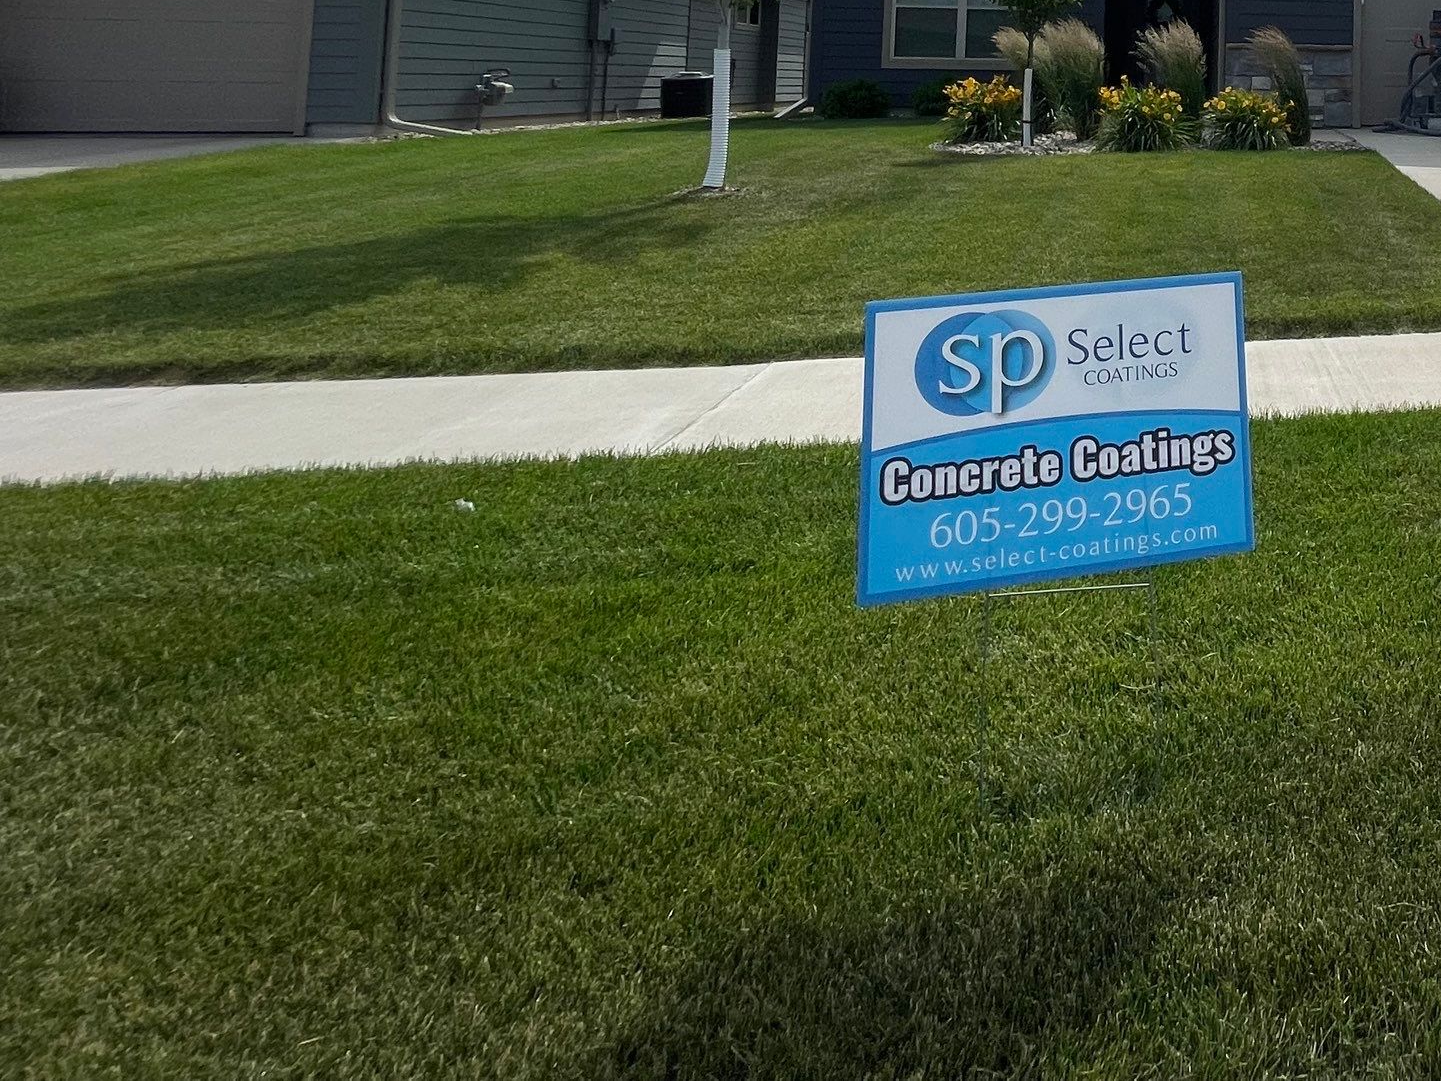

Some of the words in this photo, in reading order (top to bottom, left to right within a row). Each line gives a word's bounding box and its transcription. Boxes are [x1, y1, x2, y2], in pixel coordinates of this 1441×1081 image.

[939, 328, 1044, 414] sp
[1067, 322, 1192, 365] Select
[1083, 361, 1179, 386] COATINGS
[881, 445, 1062, 505] Concrete
[1070, 428, 1235, 480] Coatings
[930, 482, 1193, 548] 605-299-2965
[895, 521, 1218, 583] www.select-coatings.com
